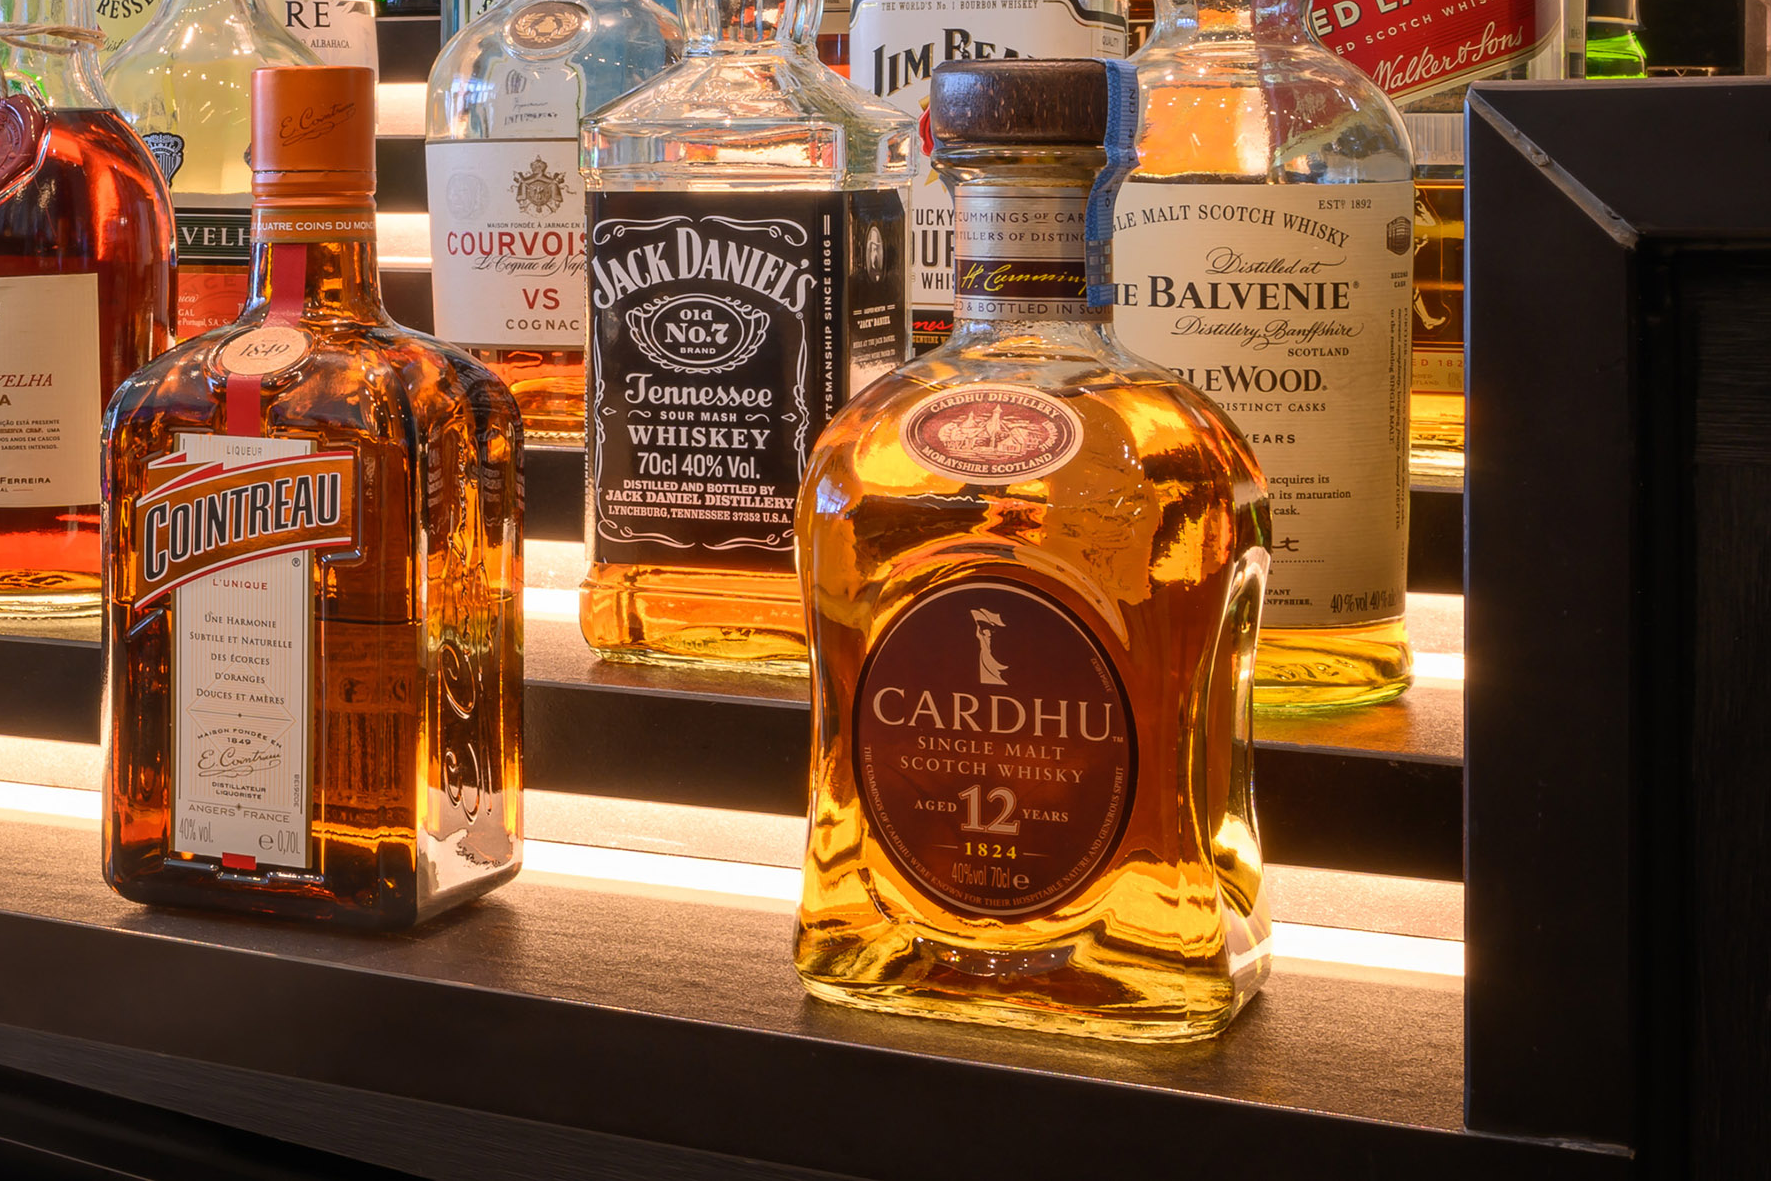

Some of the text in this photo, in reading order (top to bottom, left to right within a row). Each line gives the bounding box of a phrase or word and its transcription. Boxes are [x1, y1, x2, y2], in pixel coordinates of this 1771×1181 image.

[882, 0, 1038, 11] THE BOURBON WHISKEY
[1365, 14, 1432, 44] SCOTCH
[1373, 22, 1523, 90] Walker Sons
[1352, 199, 1372, 209] 1892
[296, 221, 351, 231] COINS DU
[1141, 205, 1350, 249] MALT SCOTCH WHISKY
[591, 226, 818, 313] JACK DANIEL'S
[1204, 247, 1299, 275] Distilled
[522, 288, 560, 311] VS
[824, 275, 832, 321] SINCE
[1148, 275, 1350, 310] BALVENIE
[680, 309, 713, 321] Old
[979, 303, 1048, 314] BOTTLED
[506, 319, 579, 331] COGNAC
[680, 347, 716, 355] BRAND
[1288, 348, 1349, 357] SCOTLAND
[624, 373, 772, 407] Tennessee
[930, 392, 1060, 418] CARDHU DISTILLERY
[1288, 403, 1326, 411] CASKS
[660, 411, 737, 422] SOUR MASH
[628, 425, 770, 450] WHISKEY
[226, 446, 262, 456] LIQUEUR
[921, 446, 1053, 473] MORAYSHIRE SCOTLAND
[638, 451, 760, 479] 70cl 40% Vol.
[623, 480, 775, 496] DISTILLED AND BOTTLED BY
[1270, 474, 1329, 487] acquires its
[606, 490, 795, 509] JACK DANIEL DISTILLERY
[1279, 489, 1351, 500] its maturation
[608, 506, 792, 524] LYNCHBURG, TENNESSEE 37352 U.S.A.
[1274, 505, 1300, 516] cask.
[144, 473, 340, 582] COINTREAU
[212, 579, 268, 591] L'UNIQUE
[227, 617, 277, 629] HARMONIE
[189, 631, 293, 649] SUBTILE NATURELLE
[211, 653, 270, 666] DES ÉCORCES
[215, 671, 266, 684] D'ORANGES
[196, 688, 285, 705] DOUCES AMÈRES
[872, 687, 1112, 742] CARDHU
[917, 735, 1065, 760] SINGLE MALT
[901, 756, 1083, 784] SCOTCH WHISKY
[212, 781, 266, 793] DISTILLATEUR
[216, 789, 262, 800] LIQUORISTE
[188, 804, 290, 823] ANGERS FRANCE
[915, 784, 1069, 835] AGED 12 YEARS
[179, 818, 214, 842] 40% vol.
[964, 842, 1018, 860] 1824
